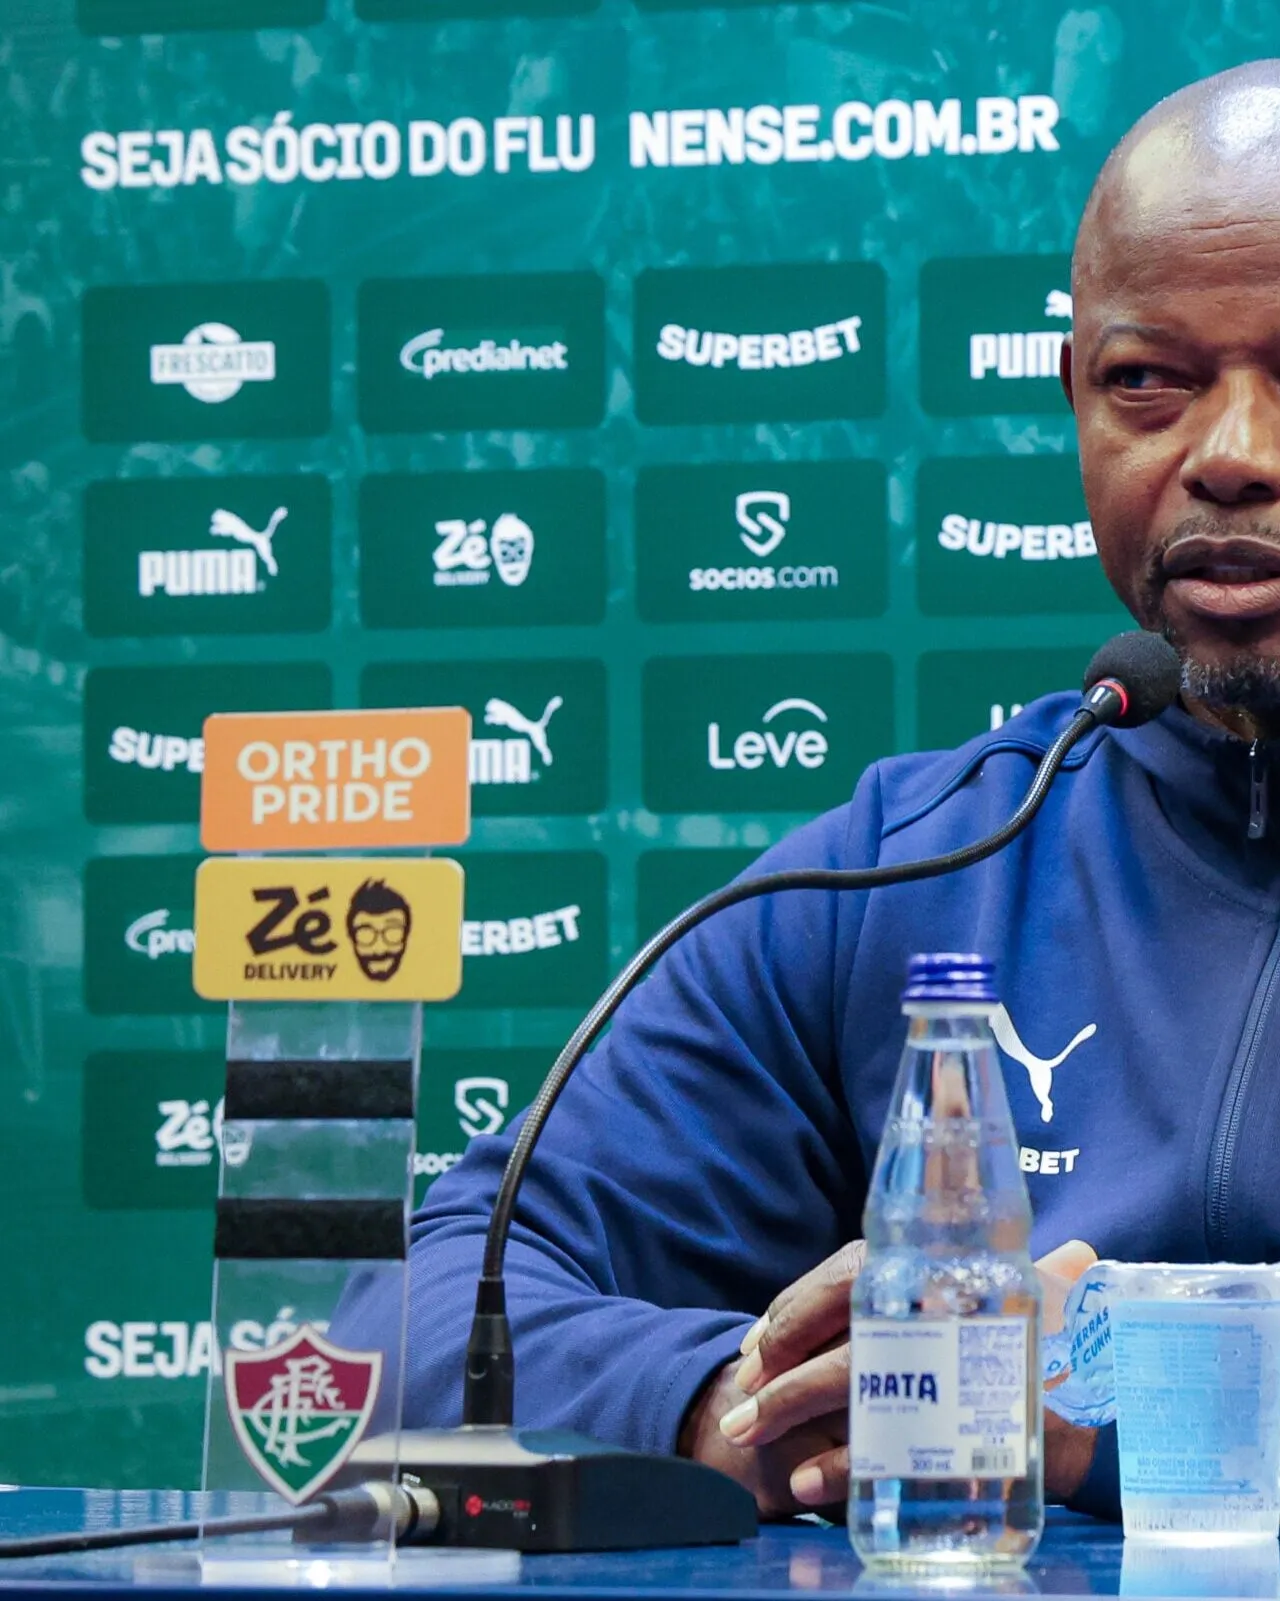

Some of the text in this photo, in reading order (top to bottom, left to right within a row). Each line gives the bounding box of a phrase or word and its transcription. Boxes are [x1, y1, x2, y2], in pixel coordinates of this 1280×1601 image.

[81, 96, 1060, 190] SEJA SÓCIO DO FLU NENSE.COM.BR
[657, 317, 862, 370] SUPERBET
[970, 330, 1073, 379] PUM
[433, 519, 492, 570] Zé
[139, 549, 257, 596] PUMA
[689, 566, 837, 590] socios.com
[236, 737, 432, 782] ORTHO
[708, 723, 828, 769] Leve
[252, 781, 414, 825] PRIDE
[246, 886, 338, 957] Zé
[244, 963, 337, 981] DELIVERY
[156, 1100, 214, 1150] Zé
[85, 1320, 222, 1378] SEJA
[859, 1372, 938, 1404] PRATA
